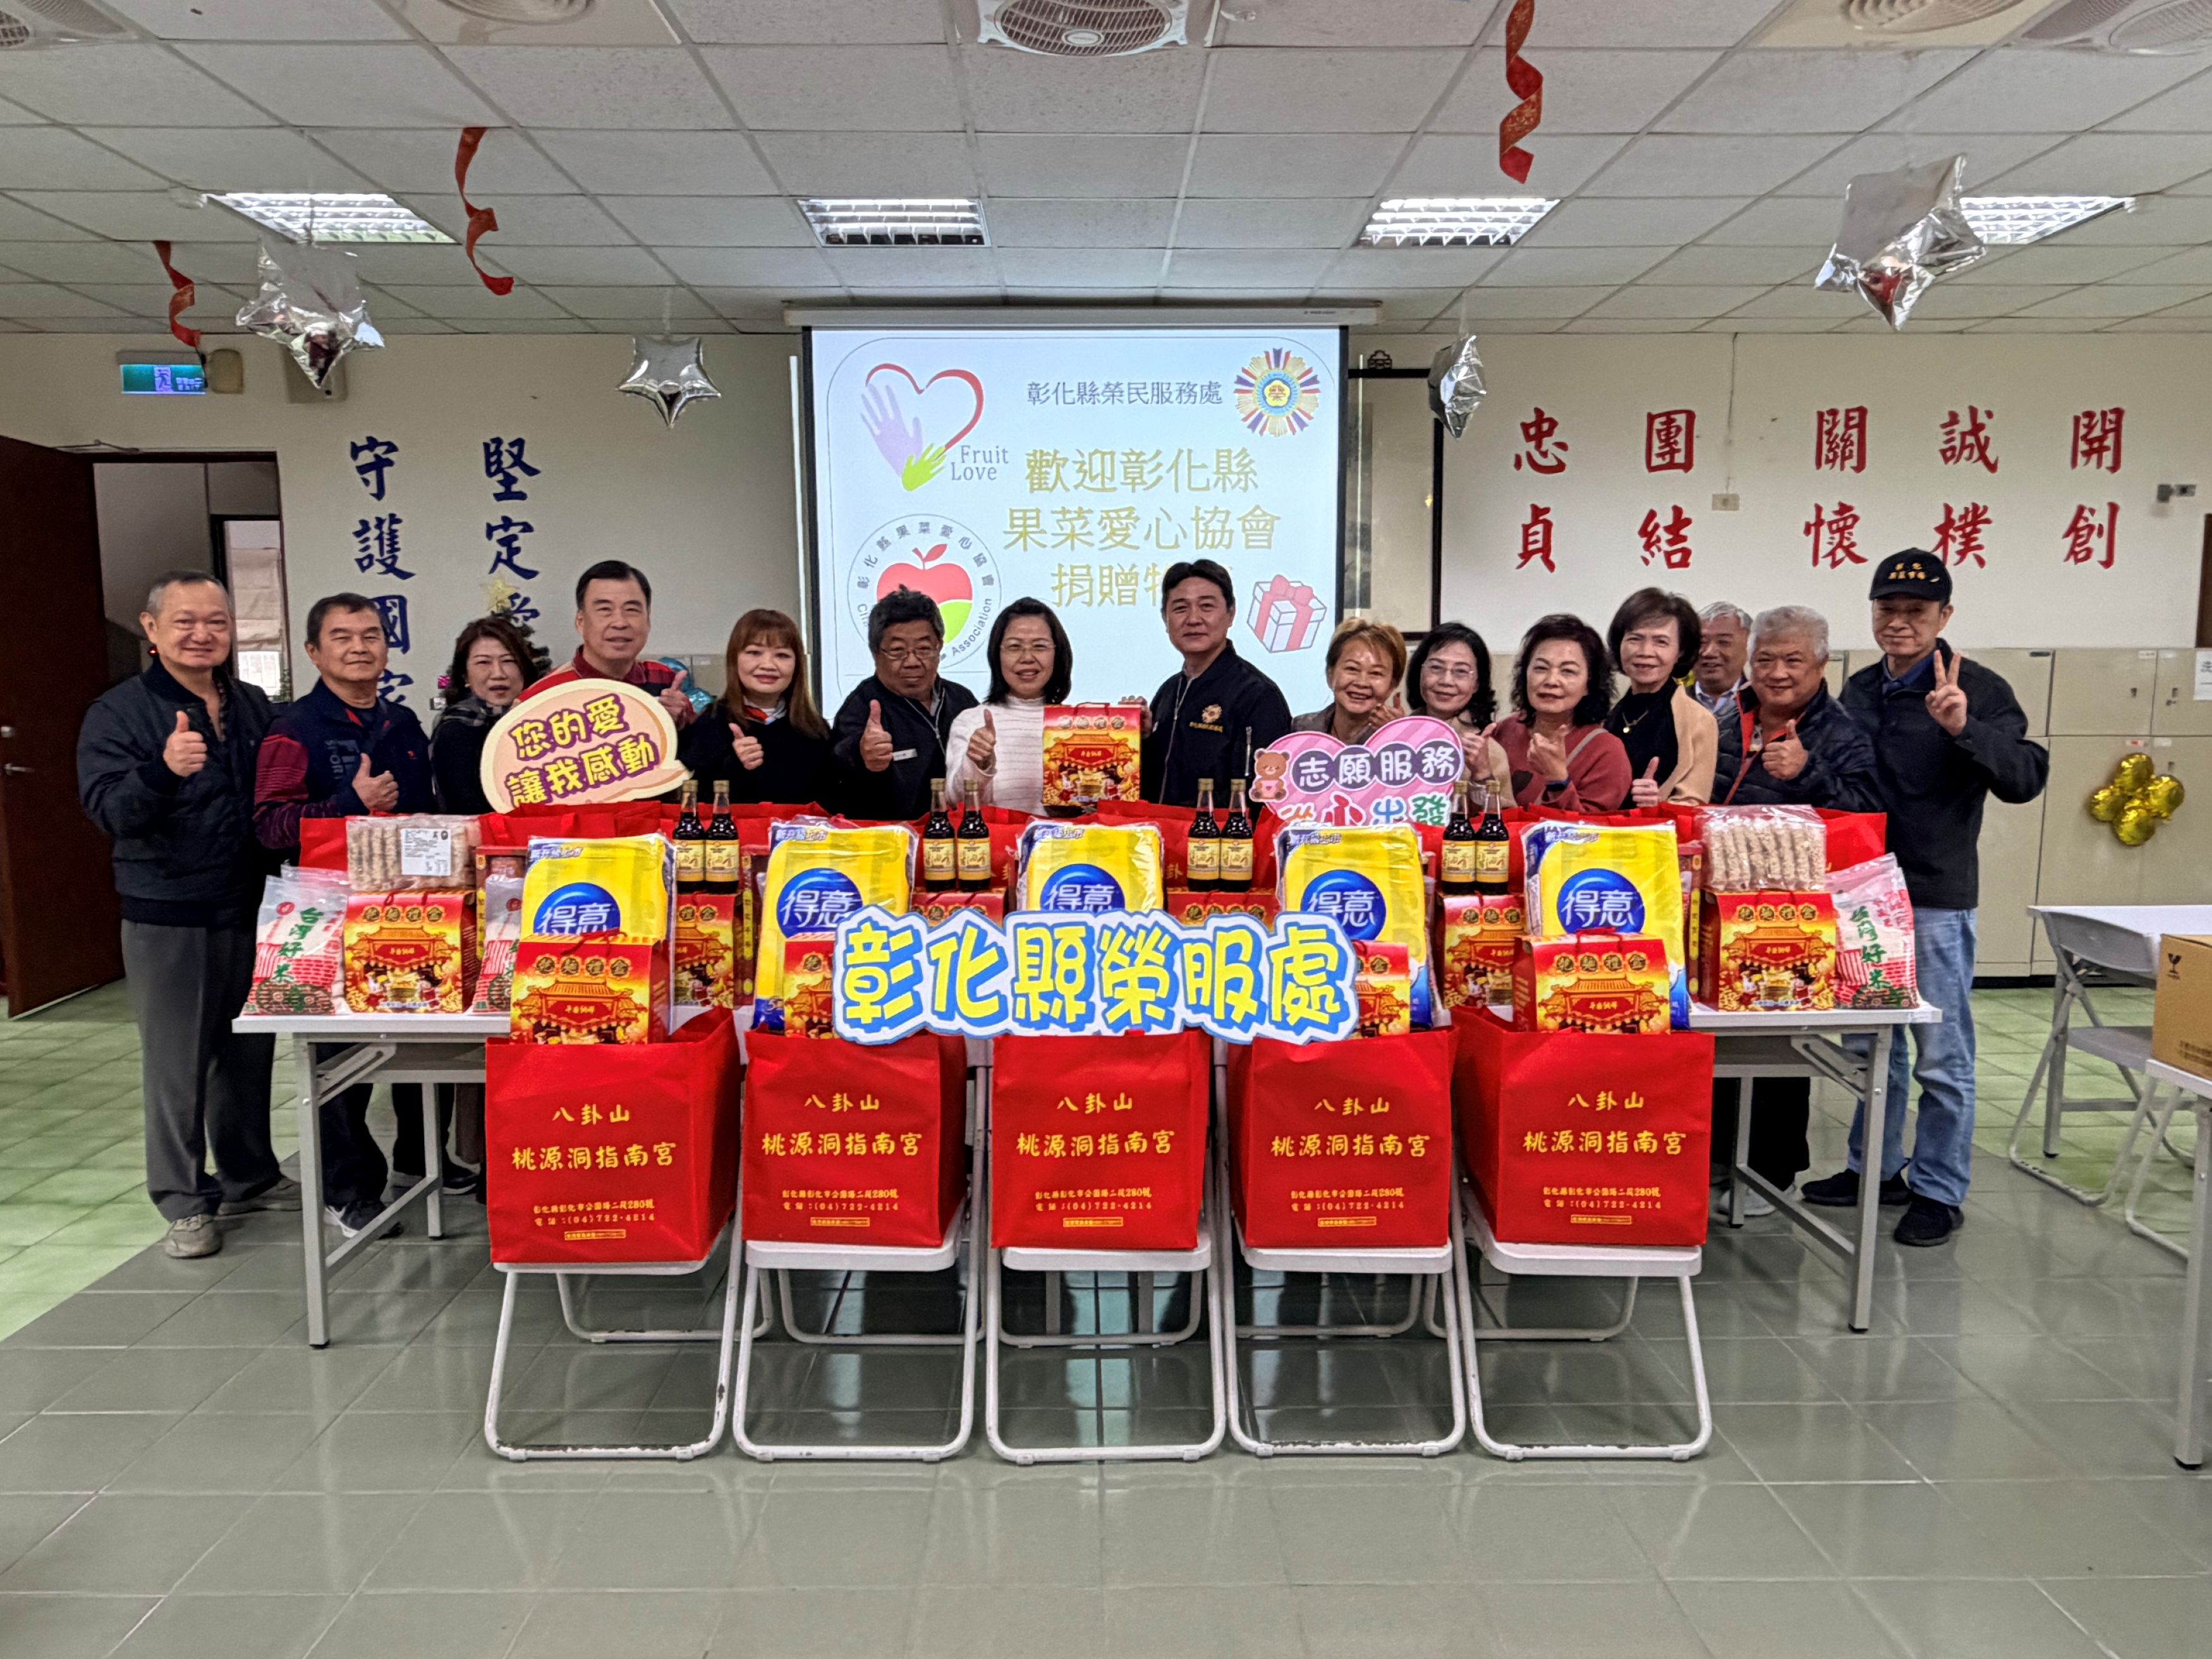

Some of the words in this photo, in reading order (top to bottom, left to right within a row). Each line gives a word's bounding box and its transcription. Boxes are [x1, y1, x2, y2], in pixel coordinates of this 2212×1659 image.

[1026, 380, 1224, 406] 彰化縣榮民服務處
[961, 444, 1009, 465] Fruit
[951, 462, 997, 481] Love
[1024, 447, 1259, 494] 歡迎彰化縣
[1003, 506, 1281, 552] 果菜愛心協會
[951, 598, 993, 657] Association
[509, 695, 626, 759] 您的愛
[506, 734, 656, 807] 讓我感動
[1299, 746, 1455, 787] 志願服務
[780, 890, 854, 927] 得意
[1044, 884, 1115, 910] 得意
[1308, 890, 1376, 927] 得意
[1561, 890, 1635, 927] 得意
[537, 902, 612, 935] 得意
[843, 921, 1342, 1026] 彰化縣榮服處
[552, 1103, 630, 1126] 八卦山
[805, 1093, 880, 1112] 八卦山
[1057, 1092, 1133, 1114] 八卦山
[1315, 1097, 1390, 1116] 八卦山
[1568, 1091, 1644, 1111] 八卦山
[511, 1141, 677, 1171] 桃源洞指南宮
[762, 1132, 922, 1157] 桃源洞指南宮
[1016, 1130, 1176, 1158] 桃源洞指南宮
[1270, 1134, 1430, 1158] 桃源洞指南宮
[1522, 1130, 1687, 1155] 桃源洞指南宮
